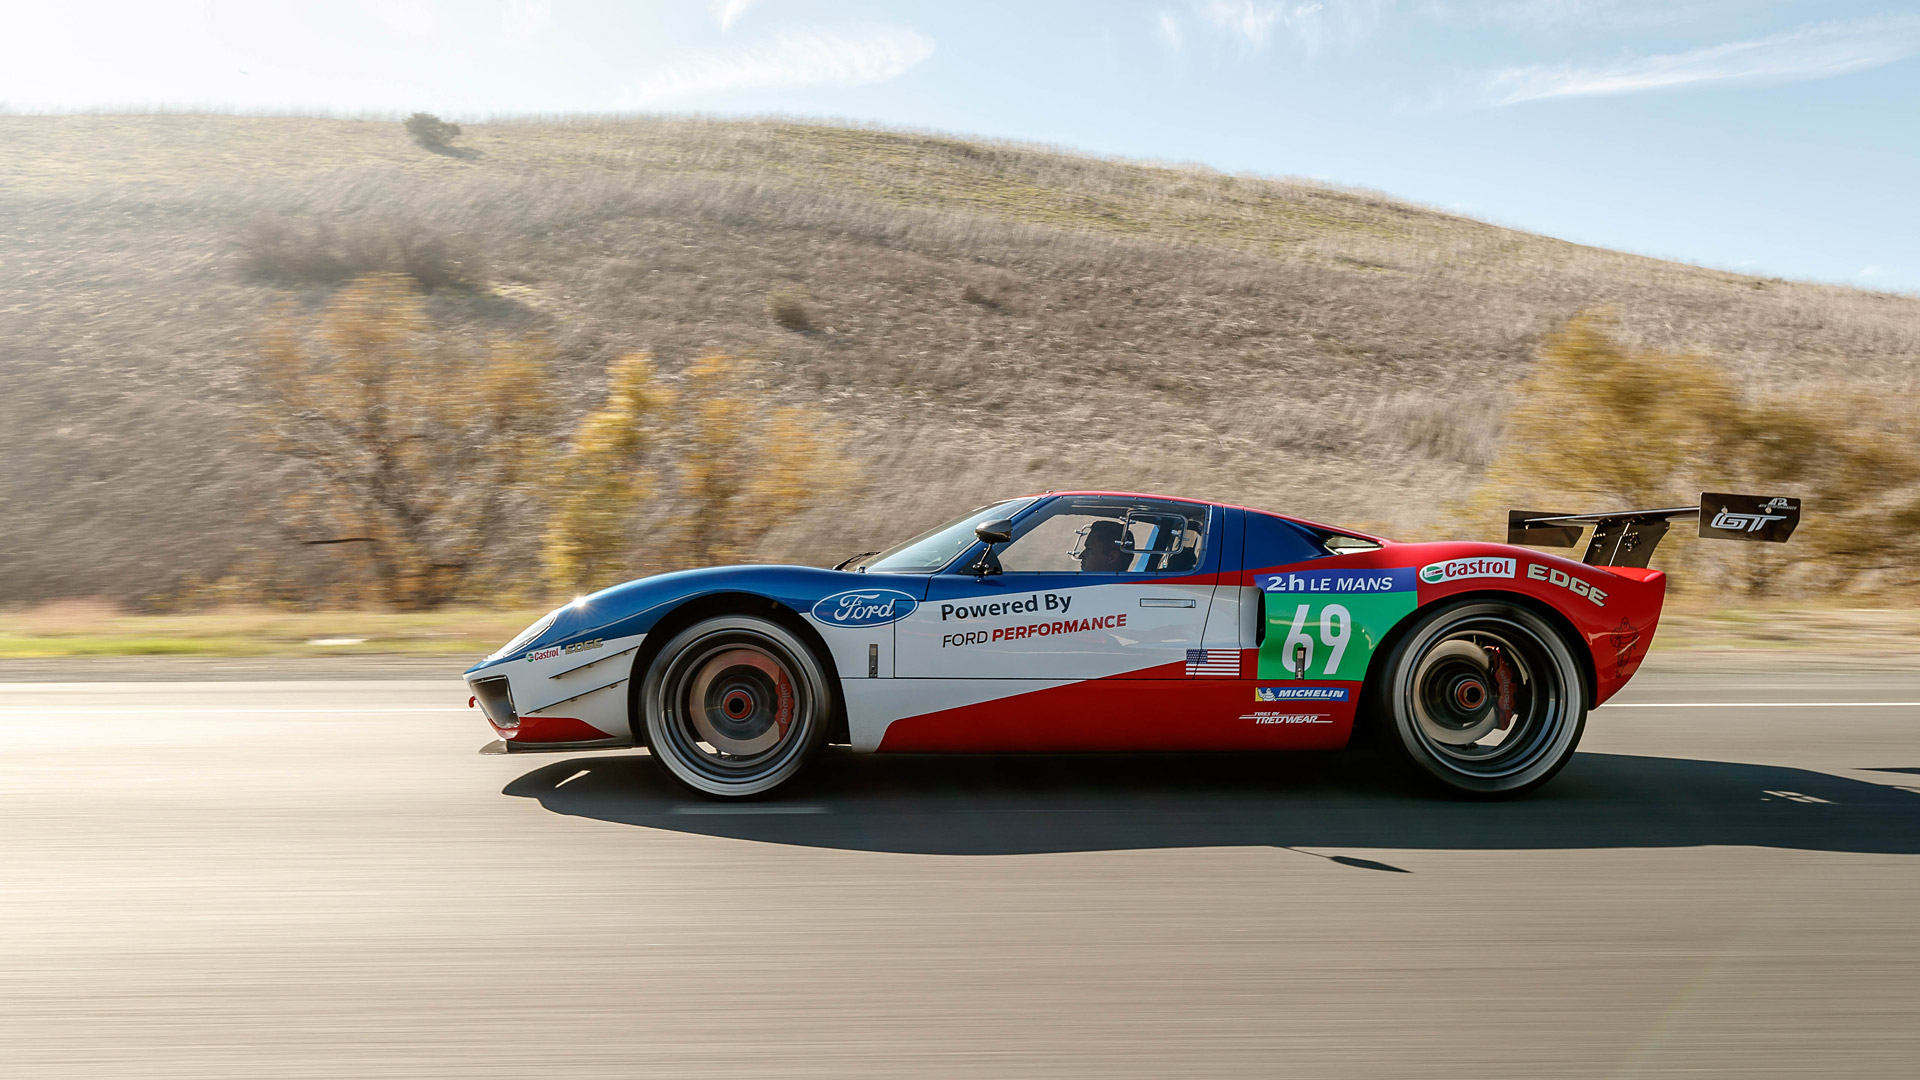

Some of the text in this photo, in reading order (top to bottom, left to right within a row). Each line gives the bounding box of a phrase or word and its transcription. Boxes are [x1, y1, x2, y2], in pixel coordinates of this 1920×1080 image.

[1710, 512, 1788, 533] GT
[1445, 559, 1511, 578] Castrol
[1266, 573, 1393, 591] 2h LE MANS
[1527, 563, 1609, 608] EDGE
[833, 593, 895, 621] Ford
[941, 593, 1072, 621] Powered By
[942, 613, 1128, 648] FORD PERFORMANCE
[1281, 603, 1352, 675] 69
[534, 648, 560, 661] Castrol
[565, 637, 604, 655] EDGE
[1278, 689, 1345, 698] MICHELIN
[1256, 715, 1319, 725] TREDWEAR
